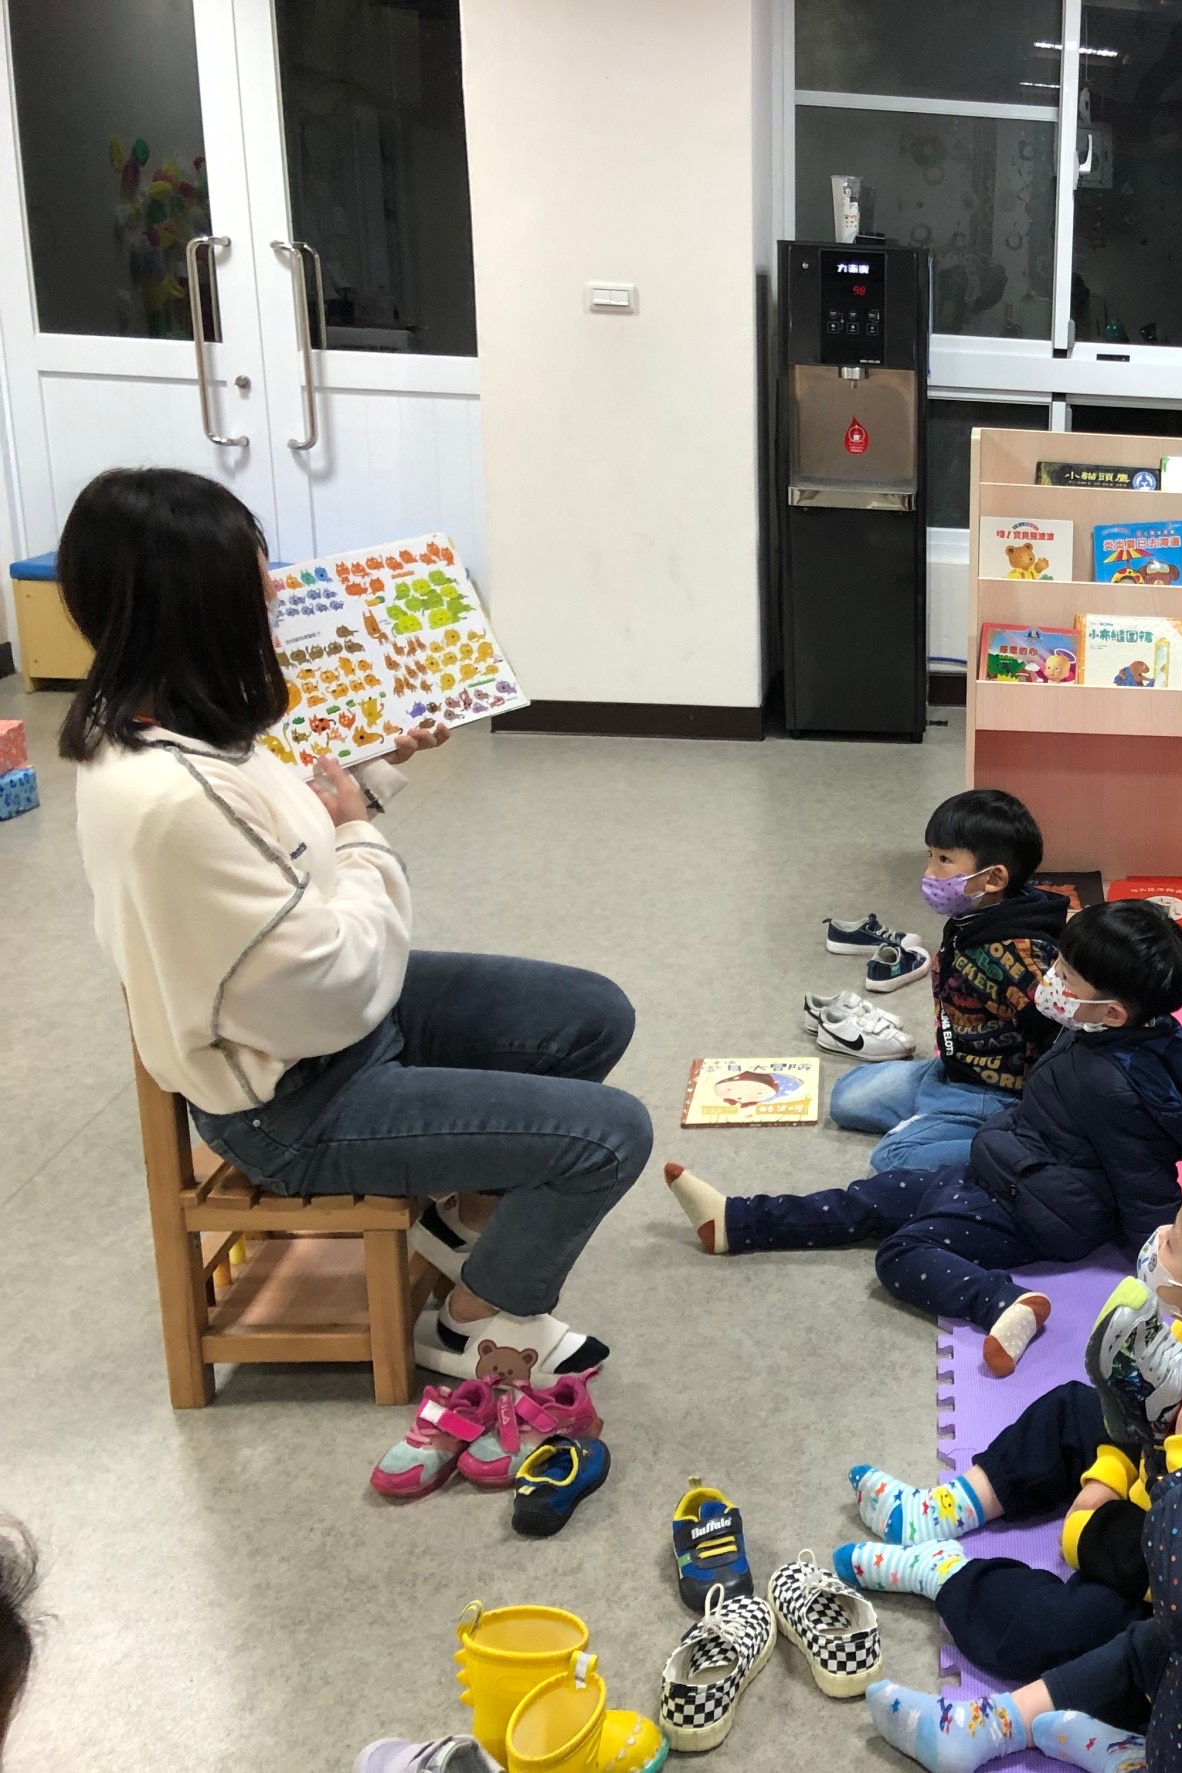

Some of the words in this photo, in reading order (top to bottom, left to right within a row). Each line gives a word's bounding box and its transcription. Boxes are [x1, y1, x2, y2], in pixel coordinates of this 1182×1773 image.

[1064, 471, 1130, 483] 小貓頭鷹
[691, 1517, 732, 1540] Buffalo
